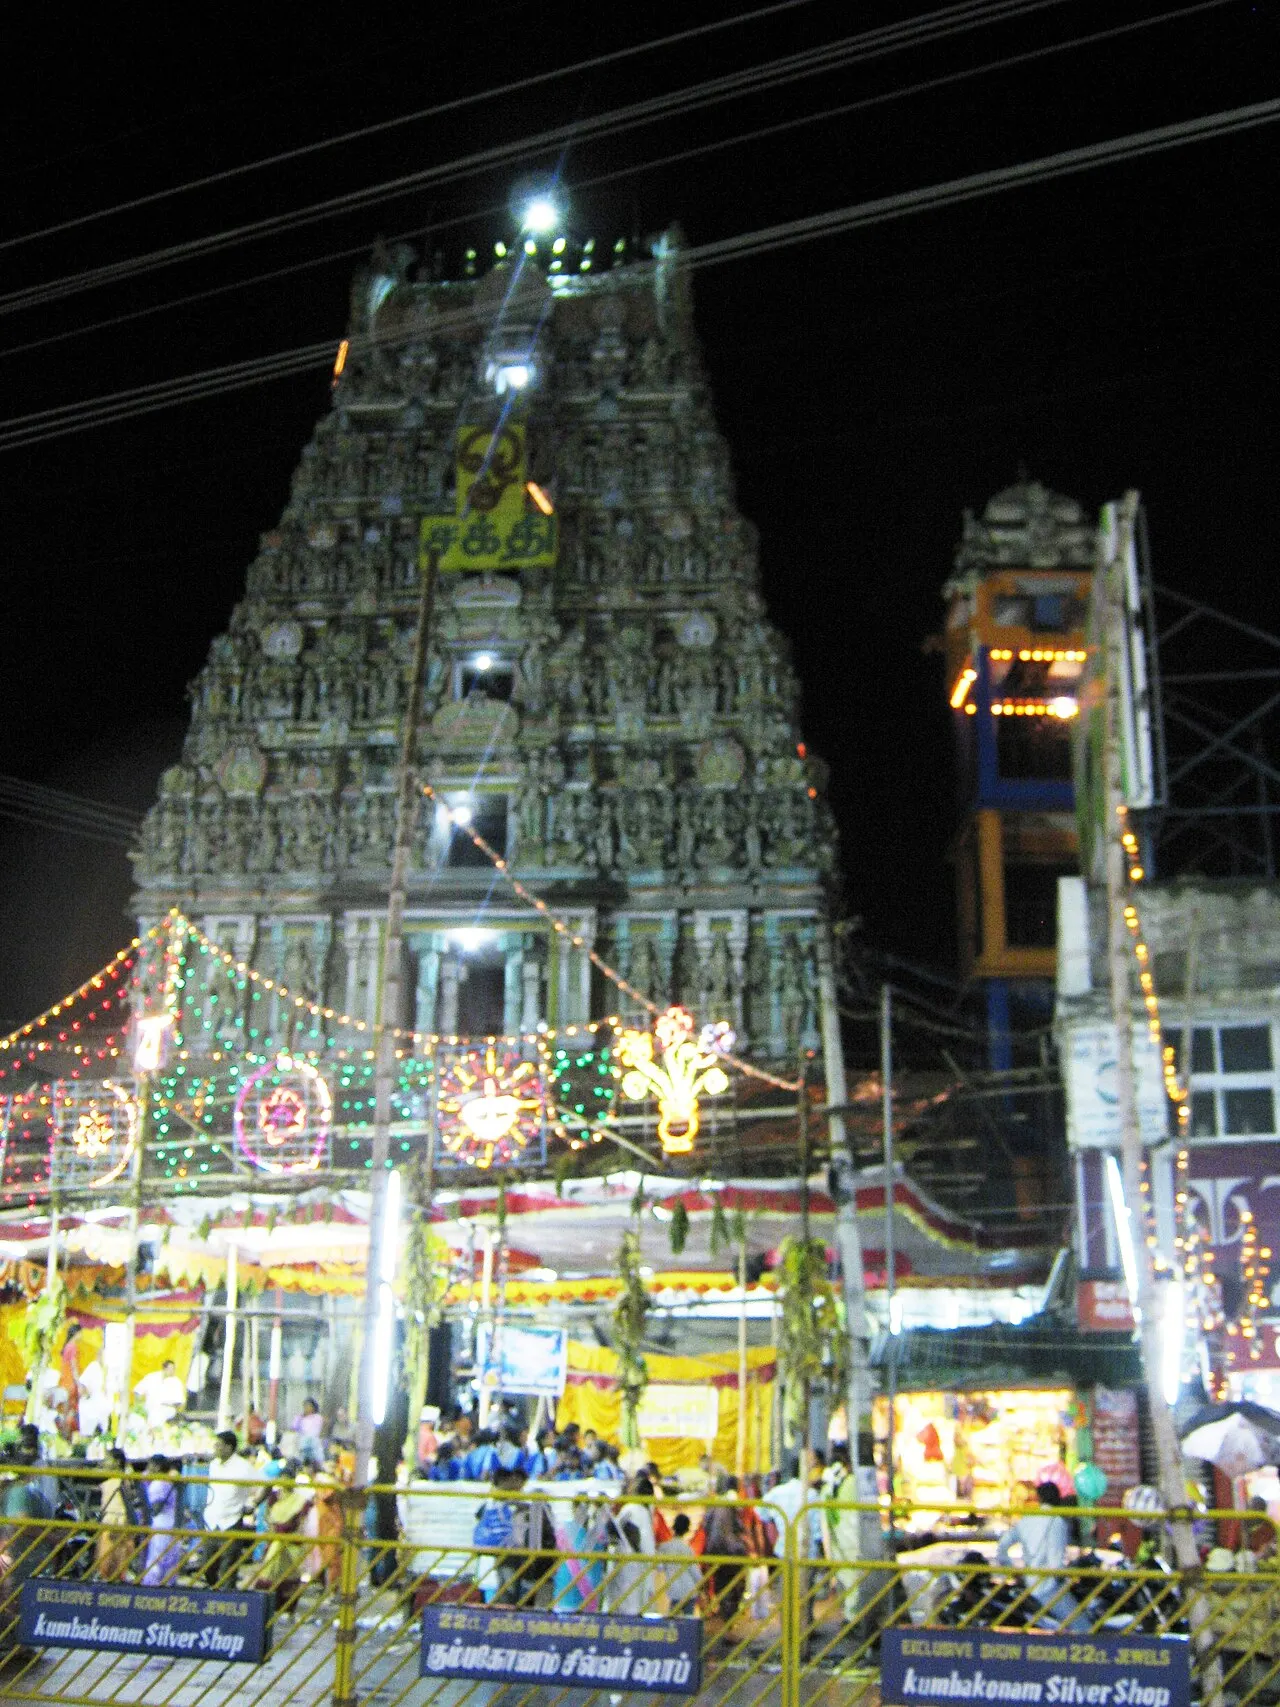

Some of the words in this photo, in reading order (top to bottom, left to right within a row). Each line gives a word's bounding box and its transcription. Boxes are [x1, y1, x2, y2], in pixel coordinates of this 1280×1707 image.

[36, 1587, 93, 1606] EXCLUSIVE
[97, 1592, 132, 1609] SHOW
[133, 1594, 167, 1611] ROOM
[203, 1599, 248, 1617] JEWELS
[145, 1622, 200, 1648] Silver
[199, 1626, 244, 1659] Shop
[901, 1638, 974, 1658] EXCLUSIVE
[980, 1642, 1022, 1660] SHOW
[1026, 1644, 1068, 1663] ROOM
[1114, 1647, 1171, 1667] JEWELS
[426, 1637, 561, 1675] கும்பகோணம்
[632, 1652, 692, 1686] ஷாப்
[1045, 1674, 1112, 1704] Silver
[1112, 1677, 1171, 1707] Shop
